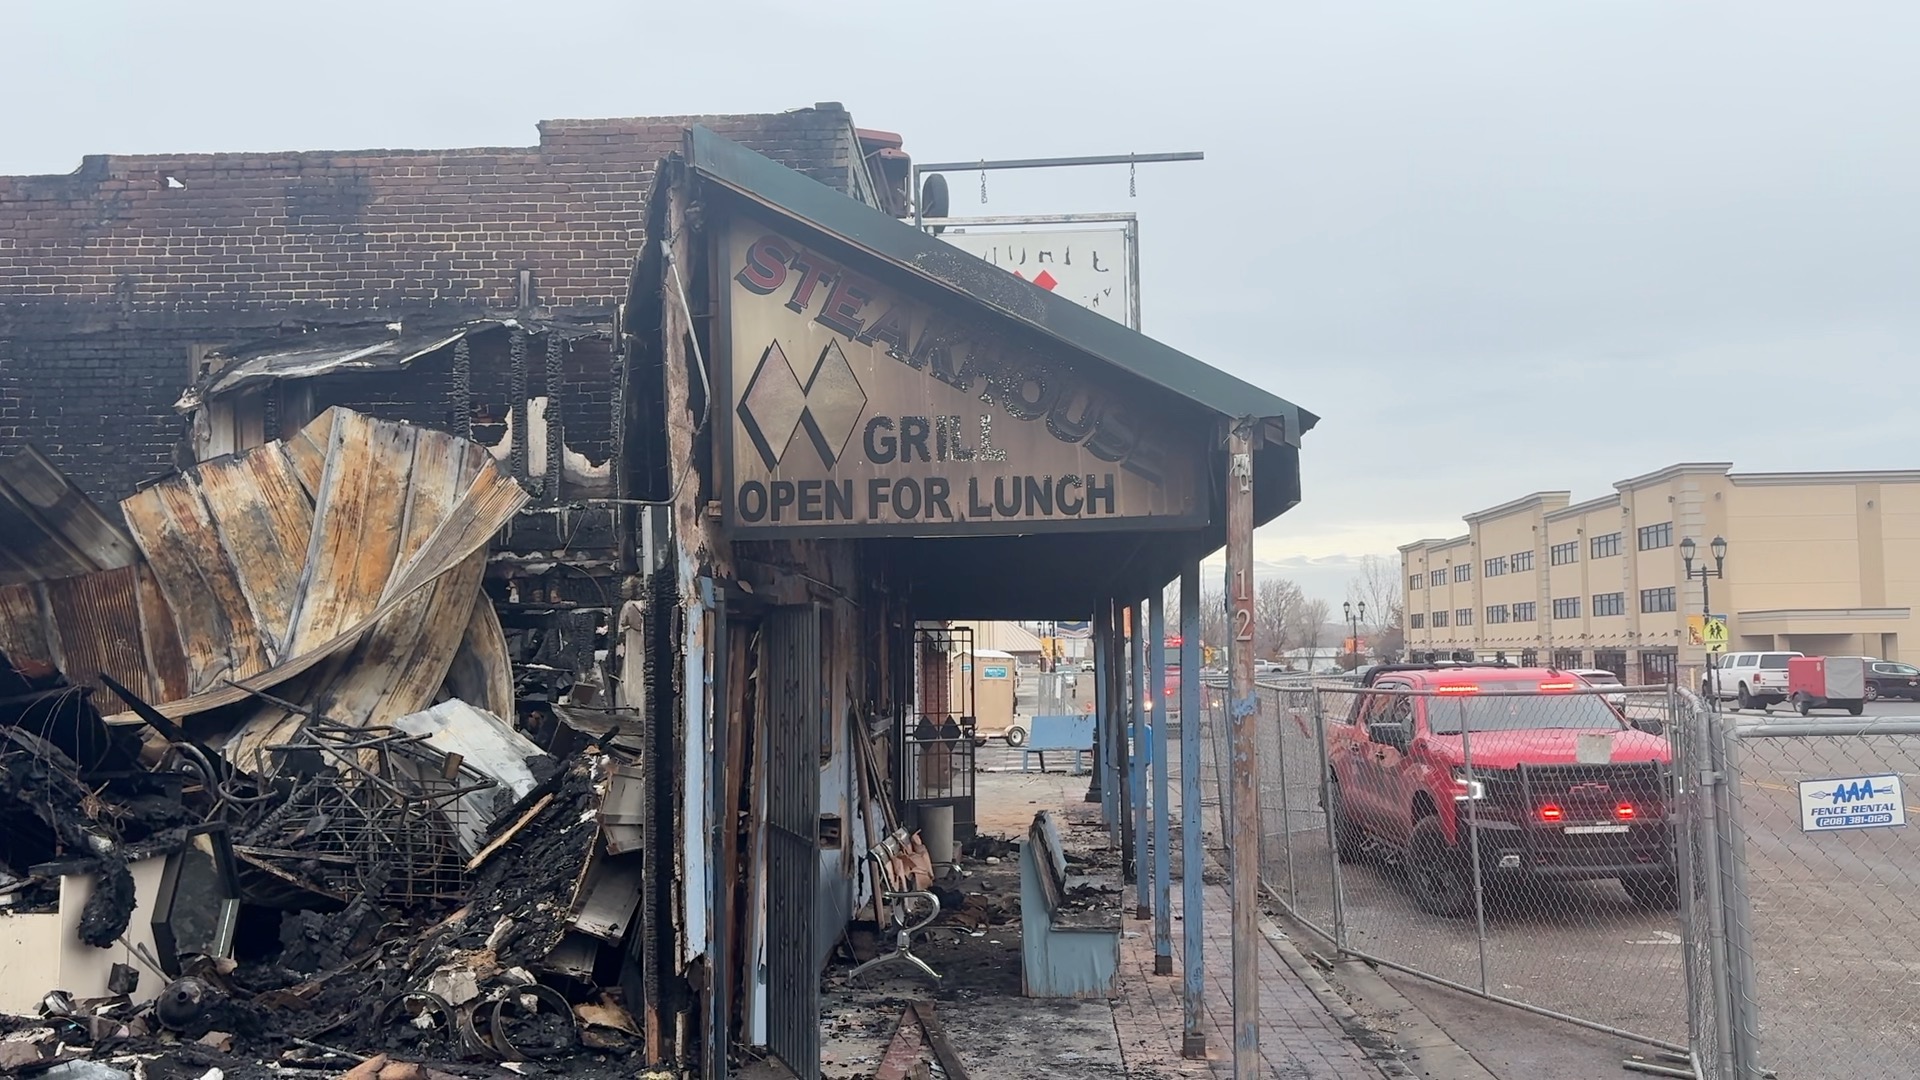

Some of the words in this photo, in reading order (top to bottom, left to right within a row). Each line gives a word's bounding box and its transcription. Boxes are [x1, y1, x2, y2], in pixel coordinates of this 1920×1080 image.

[863, 413, 1008, 466] GRILL
[737, 479, 853, 523] OPEN
[868, 477, 951, 520] FOR
[968, 474, 1115, 518] LUNCH
[1832, 779, 1874, 805] AAA
[1810, 806, 1848, 817] FENCE
[1851, 803, 1897, 815] RENTAL
[1819, 815, 1847, 827] (208)
[1848, 813, 1890, 825] 381-0126
